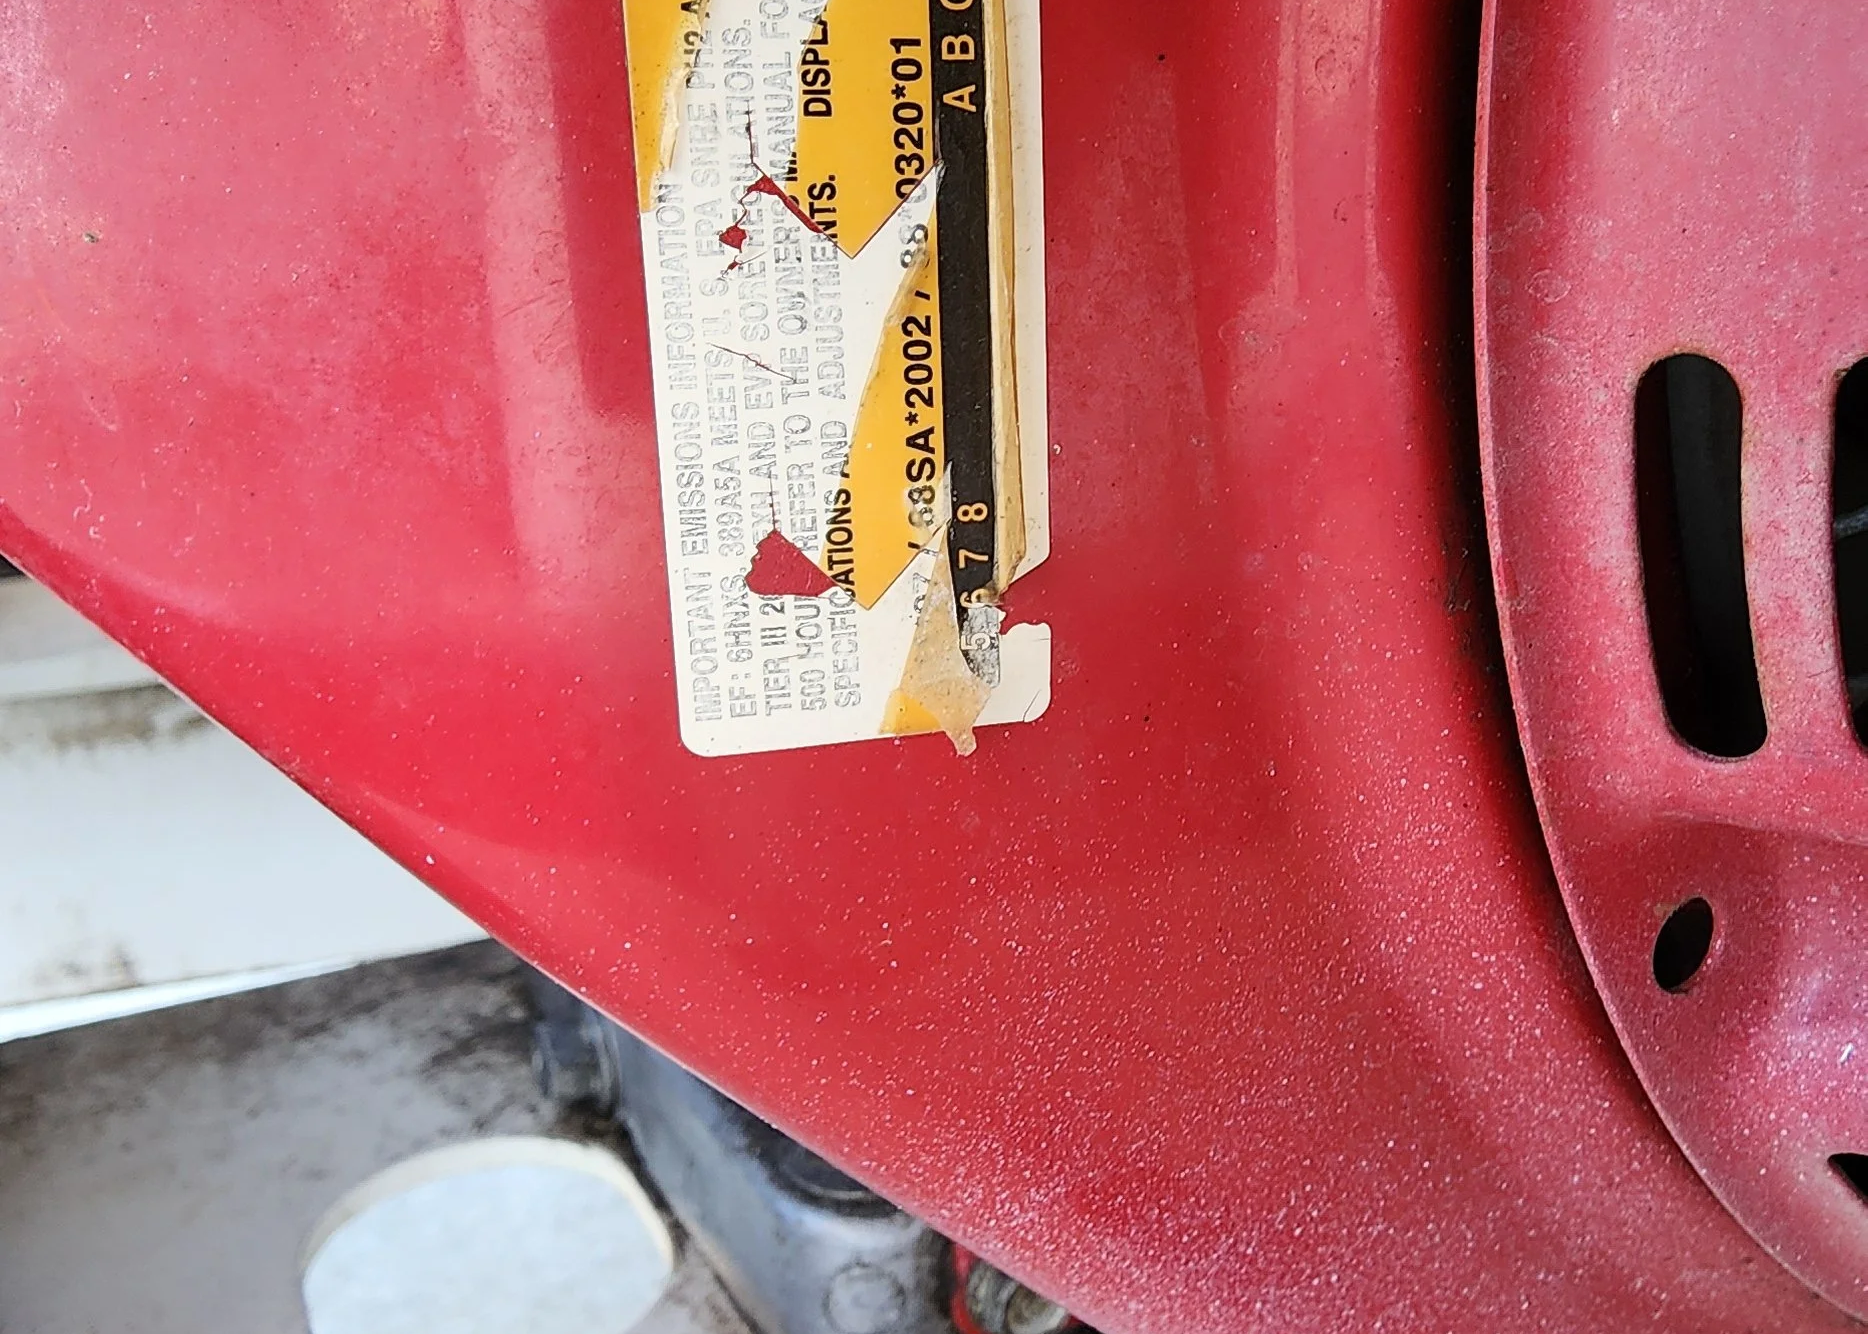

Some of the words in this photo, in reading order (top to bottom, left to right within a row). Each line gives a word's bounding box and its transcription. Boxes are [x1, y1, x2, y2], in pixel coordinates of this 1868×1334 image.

[941, 33, 976, 60] B
[763, 51, 798, 182] MANUAL
[943, 84, 977, 113] A
[694, 198, 725, 257] EPA
[656, 183, 698, 391] INFORMATION
[704, 349, 739, 446] MEETS
[779, 346, 809, 405] THE
[746, 420, 778, 480] AND
[782, 414, 812, 453] TO
[819, 420, 850, 479] AND
[671, 401, 709, 556] EMISSIONS
[786, 462, 819, 553] REFER
[956, 501, 989, 523] 8
[958, 547, 989, 570] 7
[822, 488, 862, 707] SPECIFICATIONS
[684, 567, 722, 722] IMPORTANT
[759, 625, 787, 647] III
[763, 657, 792, 716] TIER
[798, 669, 827, 711] 500
